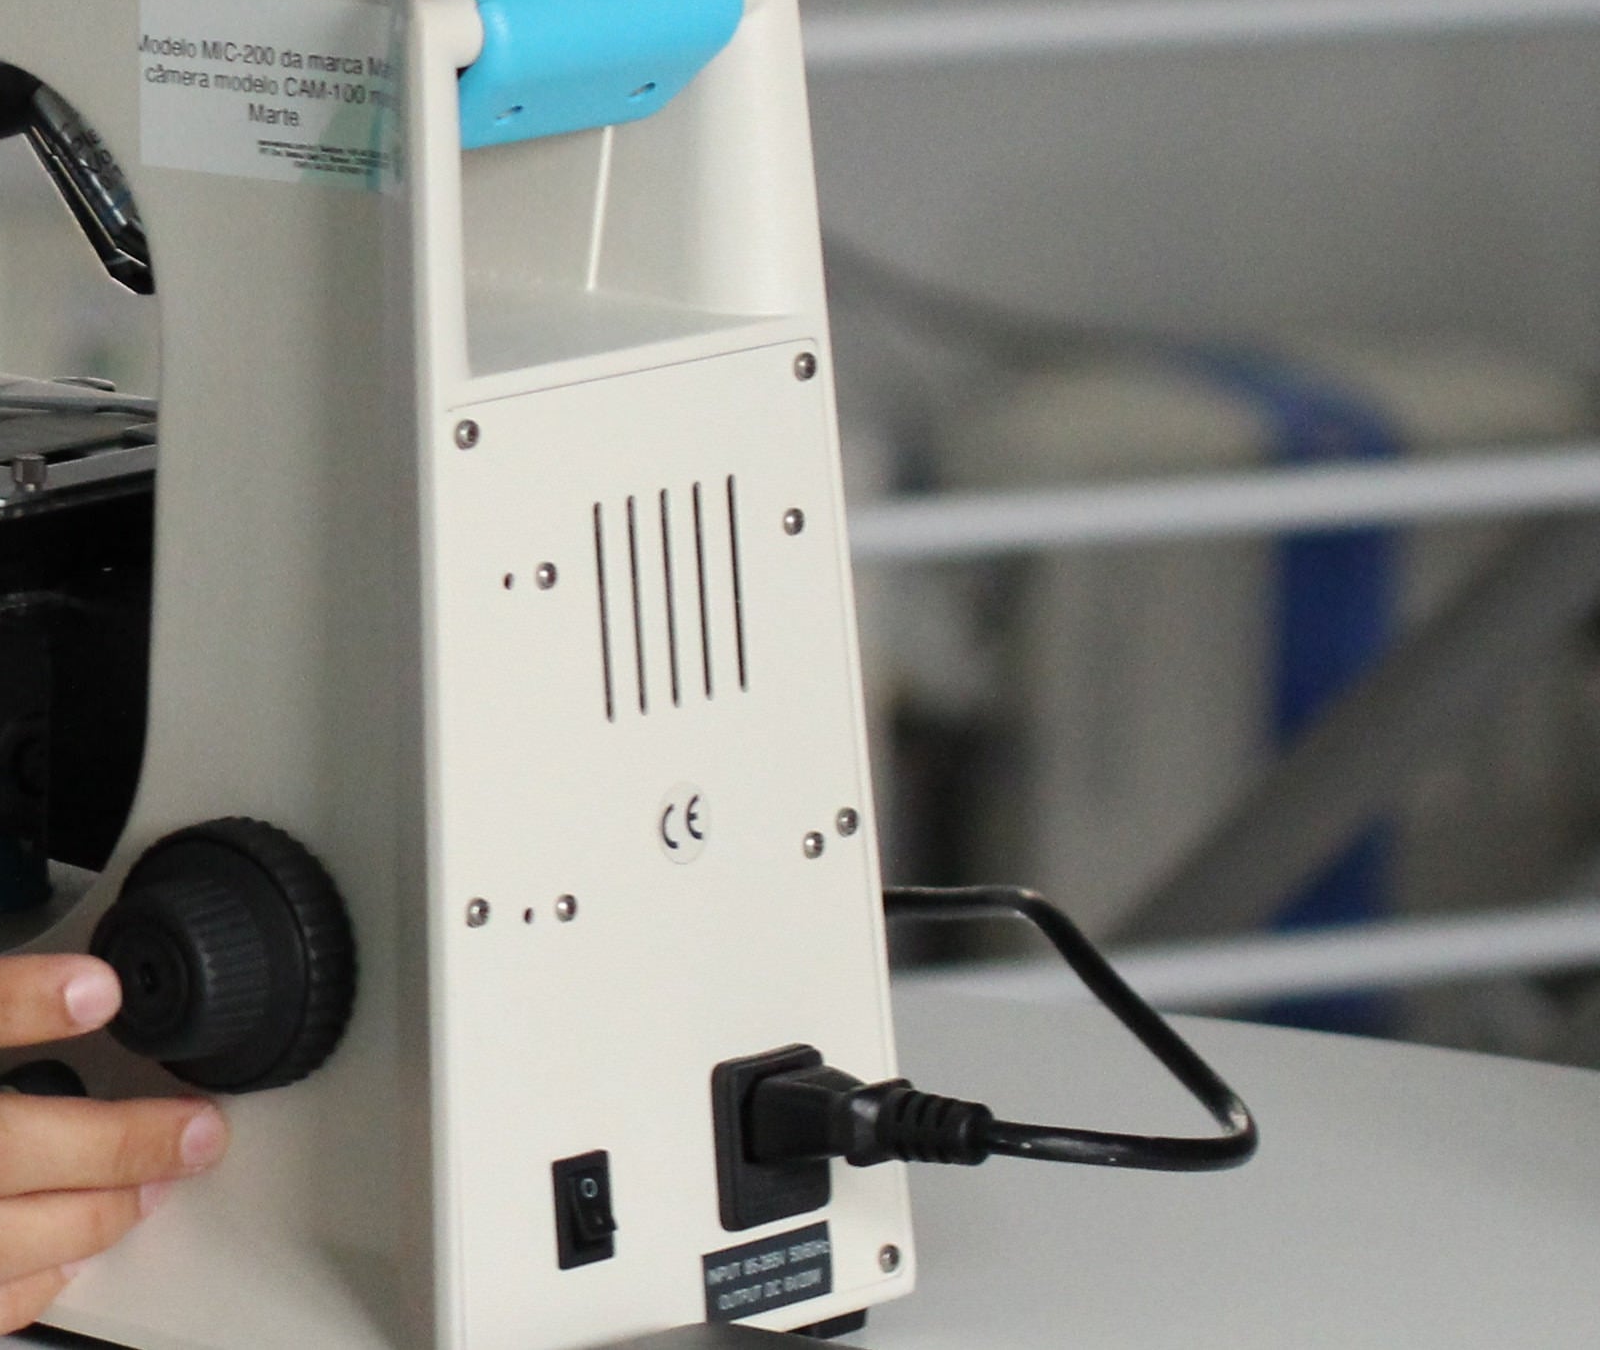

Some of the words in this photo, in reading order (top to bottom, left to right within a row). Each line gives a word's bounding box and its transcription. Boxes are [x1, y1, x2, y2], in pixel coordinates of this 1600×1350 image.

[201, 40, 275, 66] MIC-200
[280, 49, 302, 70] da
[307, 53, 362, 75] marca
[145, 63, 209, 89] câmera
[214, 72, 279, 97] modelo
[284, 77, 366, 105] CAM-100
[248, 103, 300, 128] Marte
